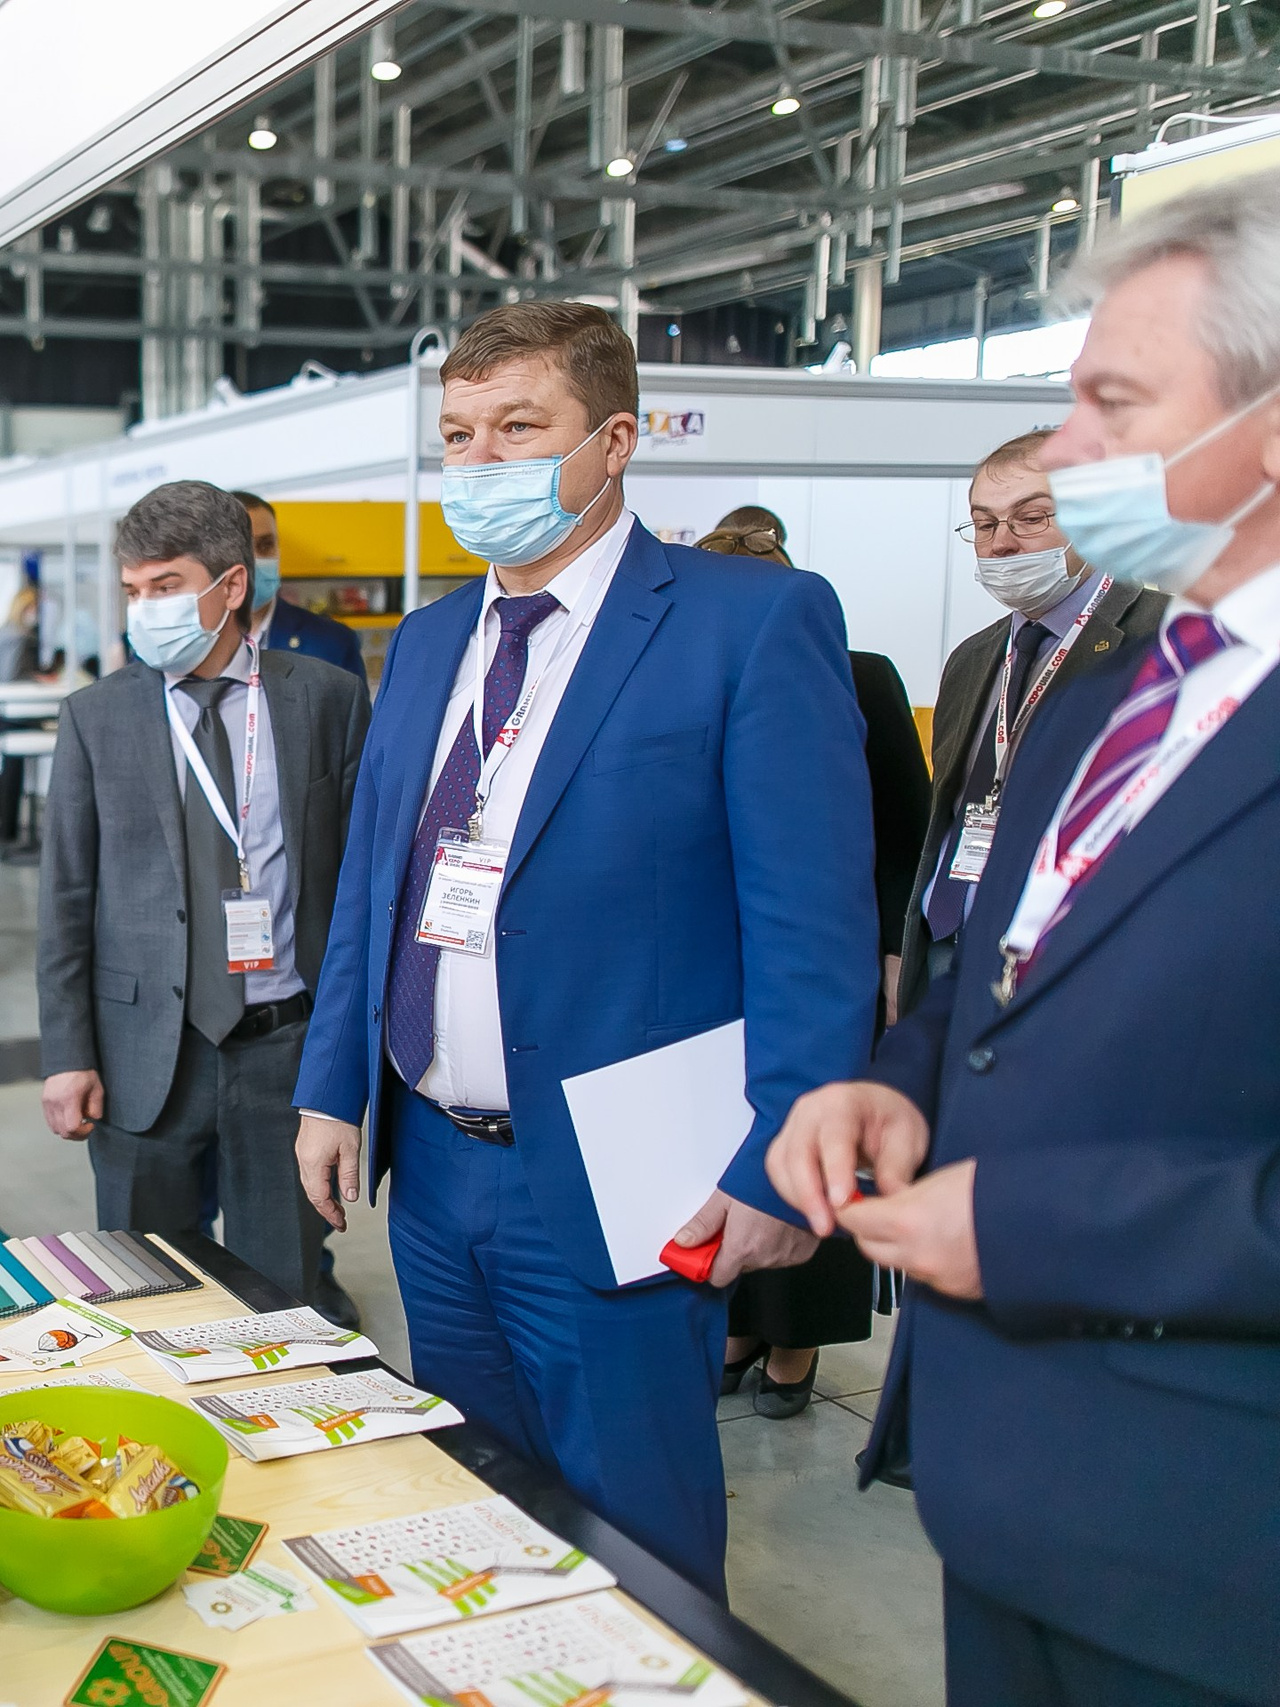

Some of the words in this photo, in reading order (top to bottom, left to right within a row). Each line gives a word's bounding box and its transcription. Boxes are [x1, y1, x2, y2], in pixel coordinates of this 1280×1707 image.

[479, 856, 492, 864] VIP
[449, 886, 474, 896] ИГОРЬ
[441, 893, 481, 905] ЗЕЛЕНКИН
[243, 960, 260, 970] VIP
